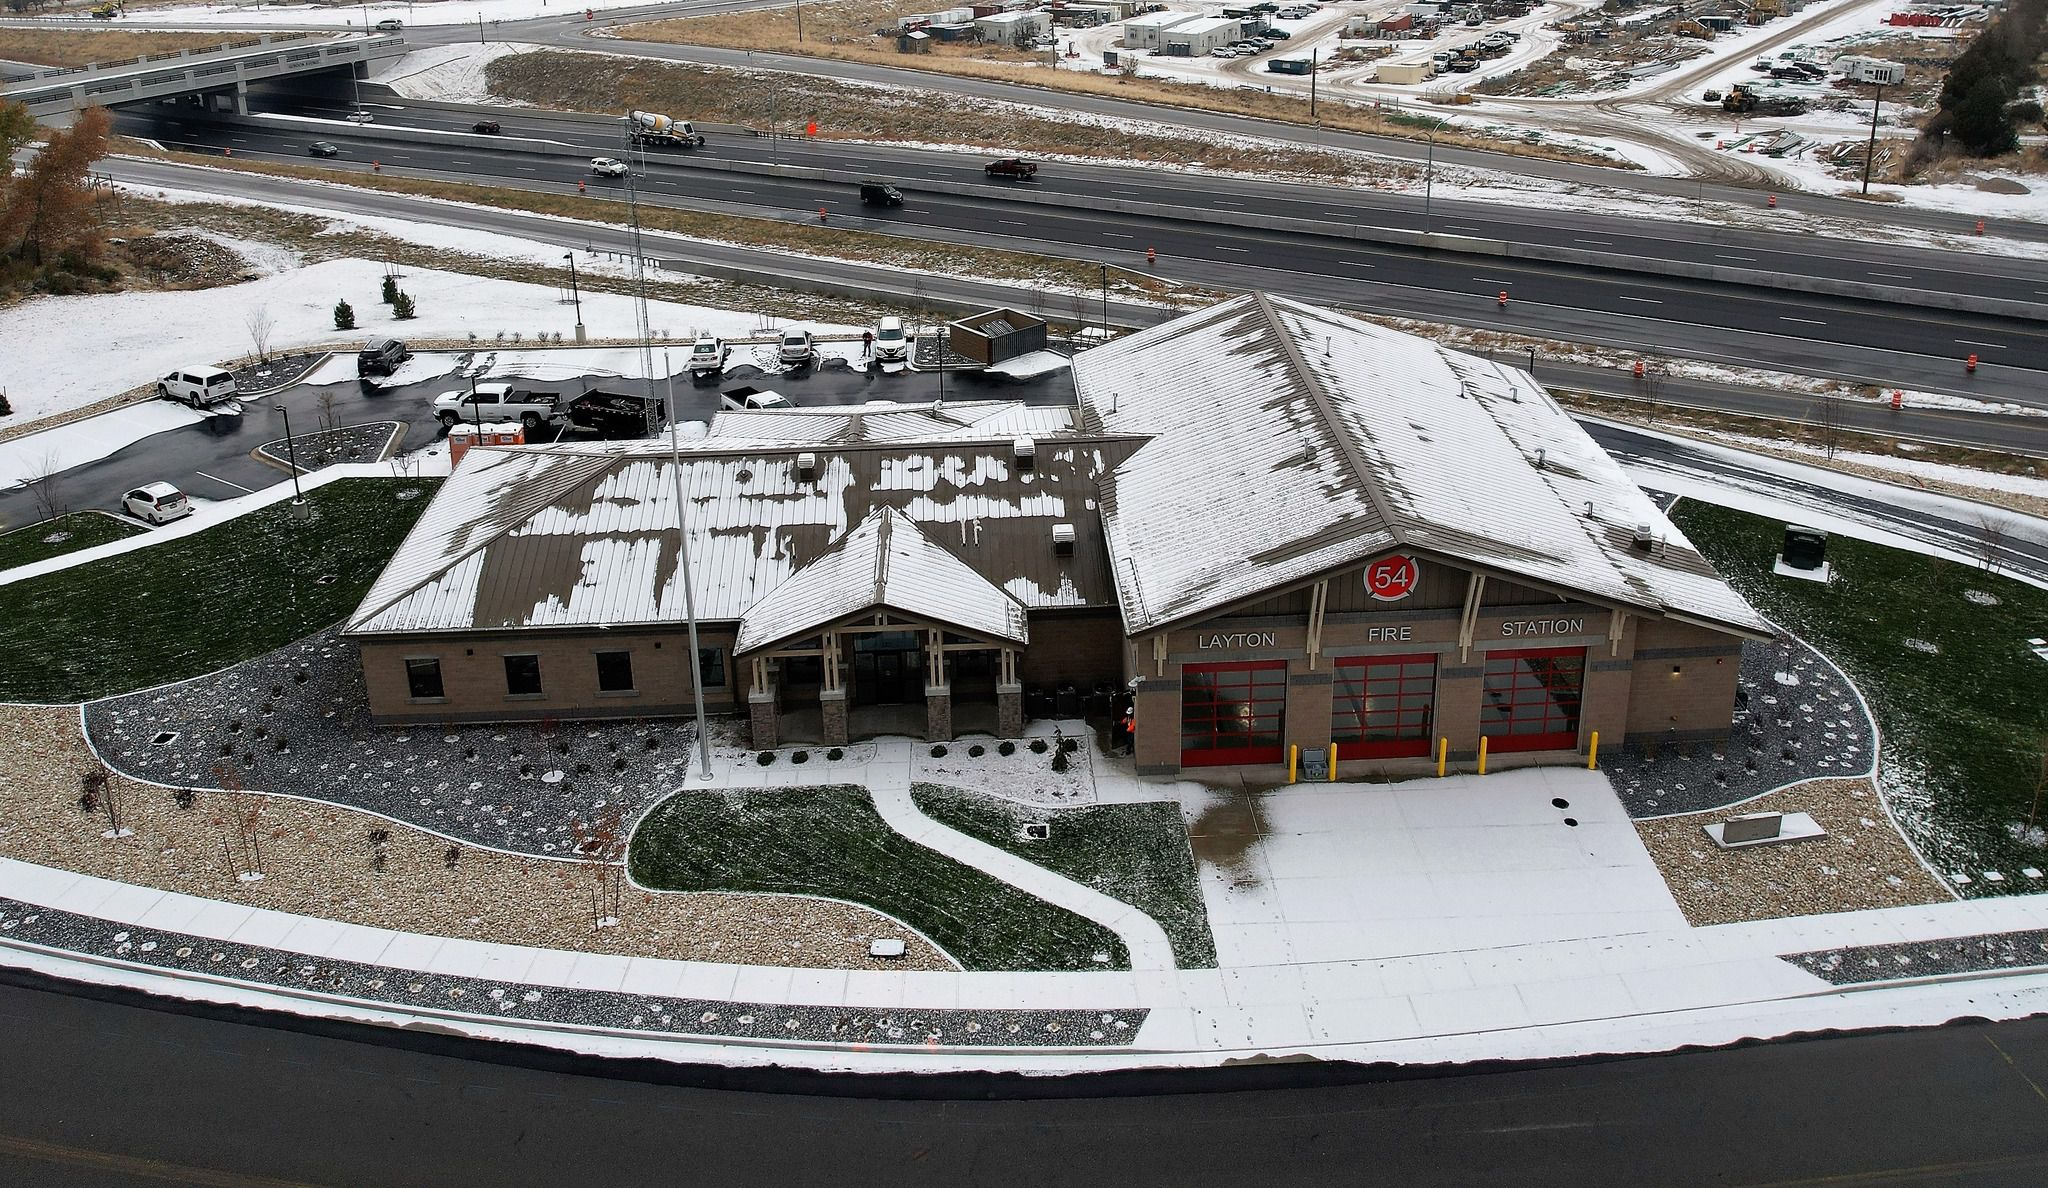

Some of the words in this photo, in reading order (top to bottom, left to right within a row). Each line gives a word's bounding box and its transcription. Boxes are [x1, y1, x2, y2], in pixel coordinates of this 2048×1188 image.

[1375, 565, 1408, 588] 54
[1199, 632, 1275, 649] LAYTON
[1368, 626, 1412, 642] FIRE
[1502, 618, 1583, 636] STATION
